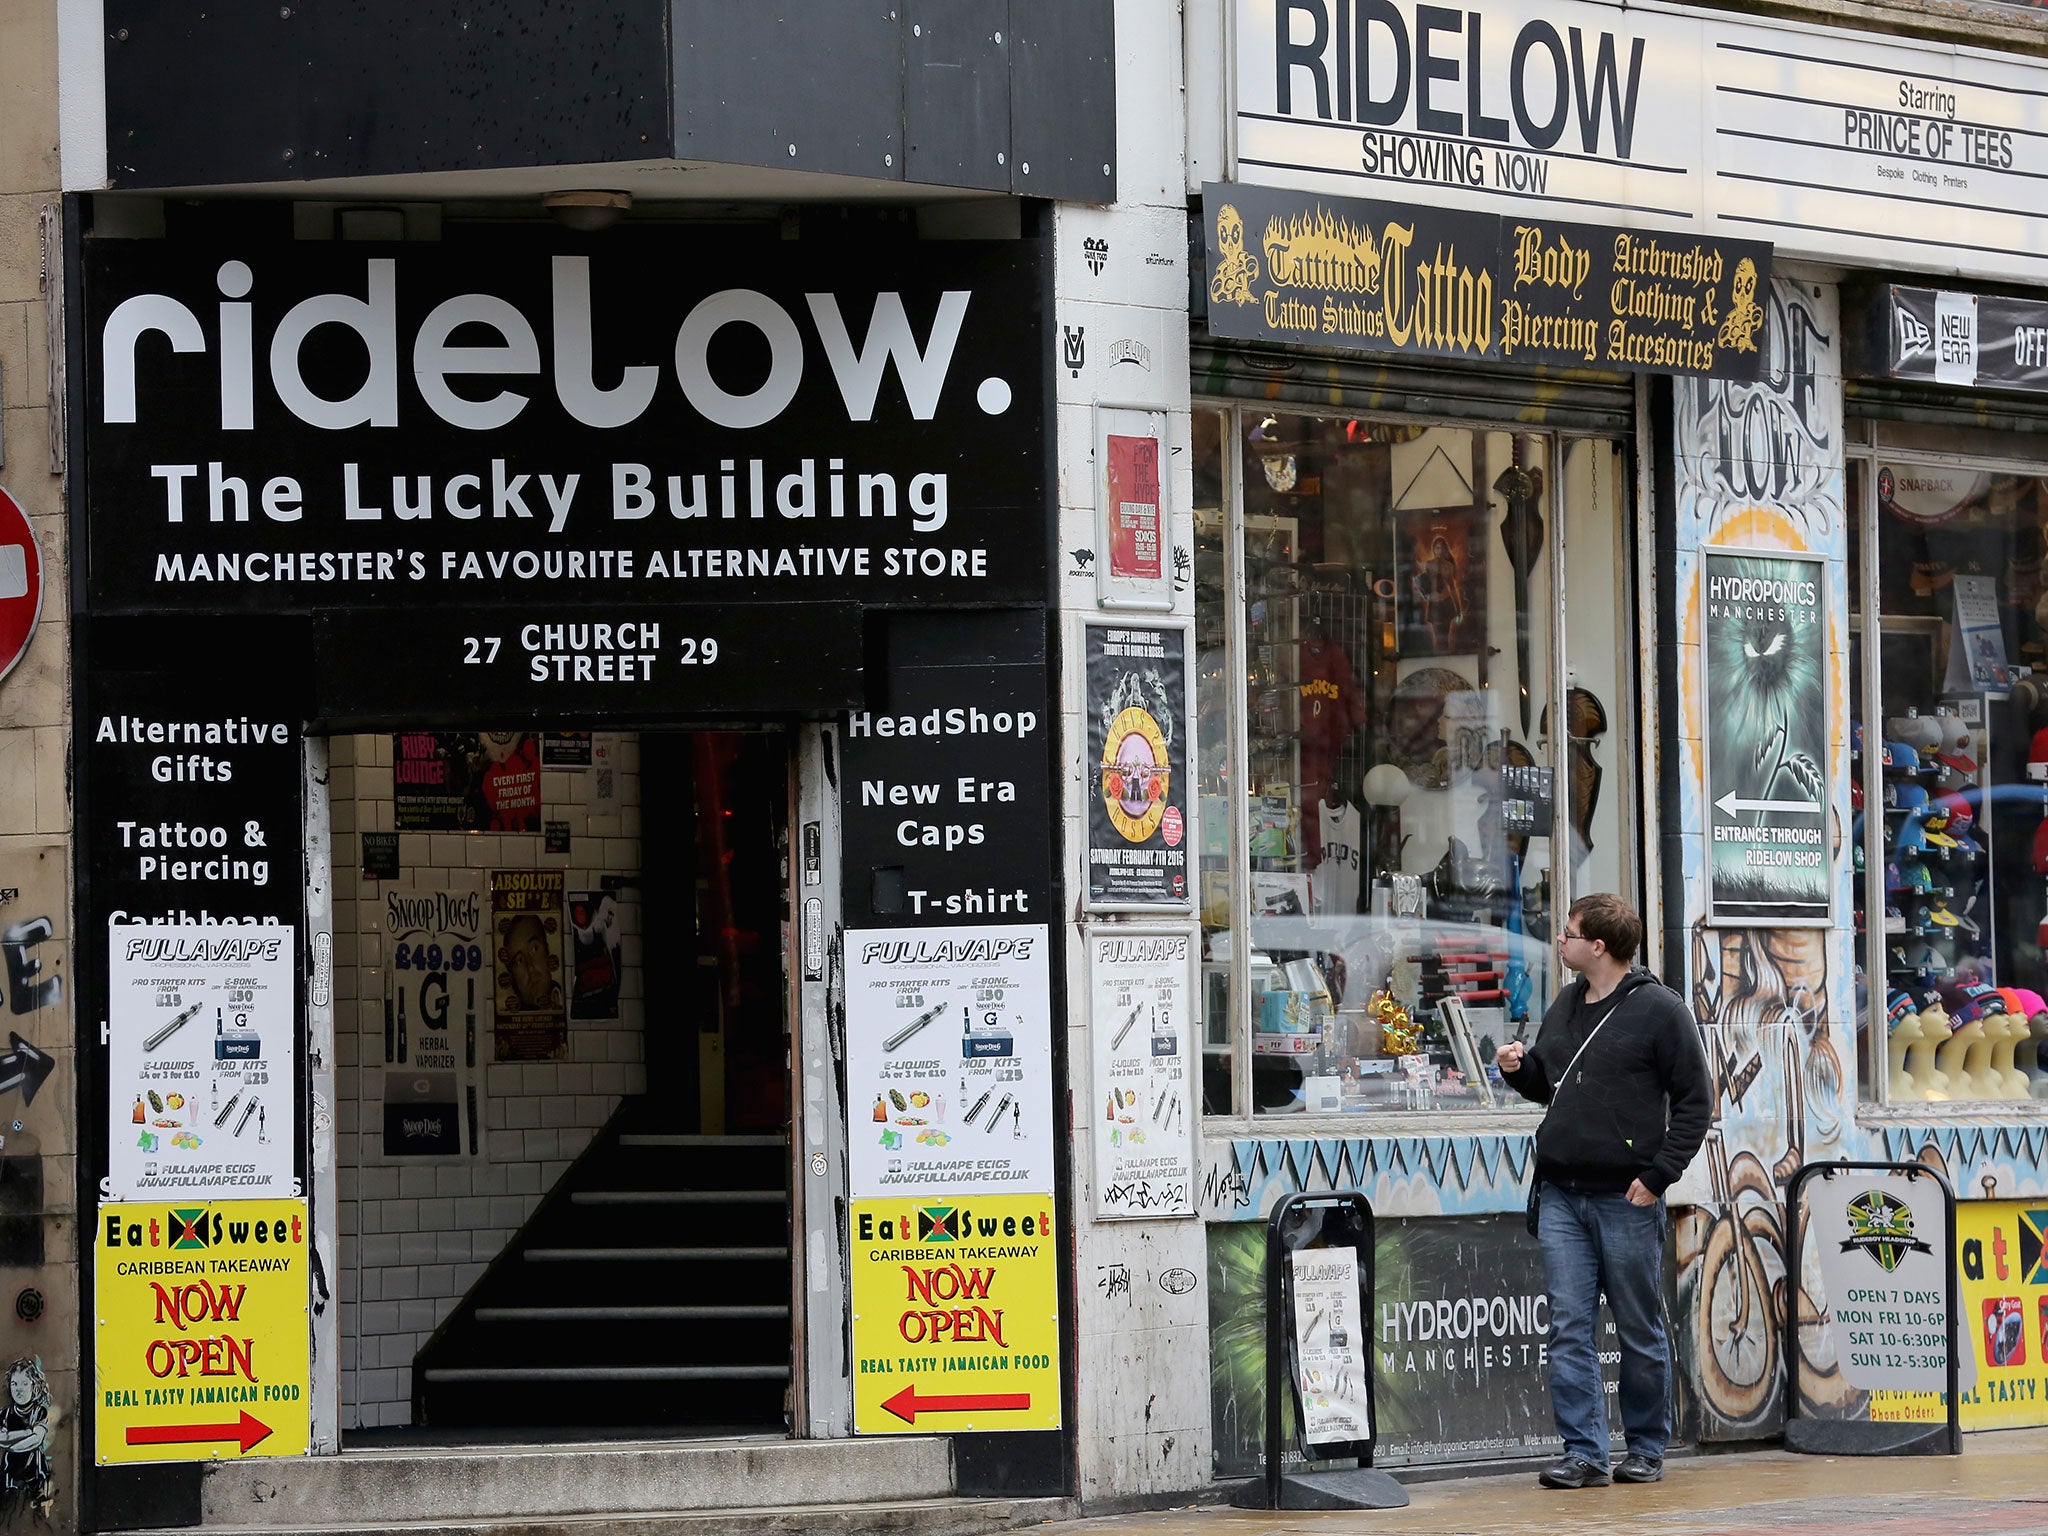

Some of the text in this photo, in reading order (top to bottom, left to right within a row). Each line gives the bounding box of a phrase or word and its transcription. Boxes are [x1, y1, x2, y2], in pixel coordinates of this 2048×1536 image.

[1277, 0, 1646, 159] RIDELOW
[1899, 80, 1956, 119] Starring
[1845, 110, 2013, 169] PRINCE OF TEES
[1362, 132, 1548, 194] SHOWING NOW
[1877, 165, 1968, 190] Bespoke Clothing Printers
[1513, 225, 1590, 301] Body
[1612, 233, 1724, 288] Airbrushed
[1381, 221, 1493, 356] Tattoo
[1263, 290, 1384, 338] Tattoo Studios
[1610, 278, 1719, 331] Clothing &
[1499, 299, 1599, 362] Piercing
[1942, 314, 1970, 340] NEW
[1942, 340, 1971, 365] ERA
[151, 458, 948, 533] The Lucky Building
[1900, 477, 1953, 493] SNAPBACK
[155, 546, 988, 583] MANCHESTER'S FAVOURITE ALTERNATIVE STORE
[1710, 575, 1815, 606] HYDROPONICS
[1710, 604, 1816, 624] MANCHESTER
[520, 622, 660, 650] CHURCH
[463, 637, 718, 664] 27 29
[530, 655, 656, 682] STREET
[96, 716, 288, 744] Alternative
[850, 707, 1036, 738] HeadShop
[401, 736, 436, 760] RUBY
[152, 754, 232, 782] Gifts
[396, 761, 444, 784] LOUNGE
[493, 772, 536, 787] EVERY FIRST
[496, 797, 535, 811] THE MONTH
[498, 785, 532, 798] FRIDAY OF
[861, 777, 1016, 806] New Era
[117, 821, 267, 847] Tattoo &
[364, 836, 397, 846] NO BIKES
[897, 820, 985, 851] Caps
[1713, 825, 1822, 845] ENTRANCE THROUGH
[1090, 848, 1120, 864] SATURDAY
[1121, 849, 1154, 865] FEBRUARY
[1167, 851, 1184, 866] 2015
[1746, 848, 1822, 867] RIDELOW SHOP
[140, 856, 269, 886] Piercing
[495, 873, 562, 891] ABSOLUTE
[908, 888, 1029, 915] T-shirt
[126, 939, 281, 961] FULLAVAPE
[395, 943, 482, 971] £49.99
[862, 938, 1034, 964] FULLAVAPE
[1099, 938, 1186, 963] FULLAVAPE
[188, 978, 206, 986] KITS
[419, 1037, 449, 1050] HERBAL
[144, 1061, 195, 1070] E-LIQUIDS
[211, 1060, 268, 1070] MOD KITS
[415, 1055, 455, 1068] VAPORIZER
[884, 1060, 941, 1070] E-LIQUIDS
[913, 1070, 926, 1078] for
[959, 1057, 1021, 1068] MOD KITS
[170, 1071, 182, 1079] for
[162, 1164, 256, 1175] FULLAVAPE ECIGS
[907, 1159, 1011, 1171] FULLAVAPE ECIGS
[106, 1213, 302, 1247] Eat & Sweet
[858, 1210, 1050, 1240] Eat & Sweet
[870, 1246, 1039, 1262] CARIBBEAN TAKEAWAY
[1963, 1226, 2009, 1281] at
[117, 1258, 291, 1276] CARIBBEAN TAKEAWAY
[901, 1263, 996, 1307] NOW
[1847, 1289, 1940, 1304] OPEN 7 DAYS
[149, 1279, 247, 1331] NOW
[1837, 1310, 1873, 1323] MON
[1879, 1311, 1901, 1325] FRI
[899, 1305, 1009, 1348] OPEN
[1382, 1294, 1549, 1343] HYDROPONIC
[1849, 1332, 1874, 1345] SAT
[145, 1334, 259, 1383] OPEN
[861, 1355, 1050, 1373] REAL TASTY JAMAICAN FOOD
[1383, 1344, 1548, 1374] MANCHESTE
[1851, 1353, 1881, 1367] SUN
[105, 1384, 300, 1407] REAL TASTY JAMAICAN FOOD
[1988, 1378, 2036, 1402] TASTY
[1871, 1405, 1934, 1421] Phone Orders
[1390, 1443, 1410, 1456] Email:
